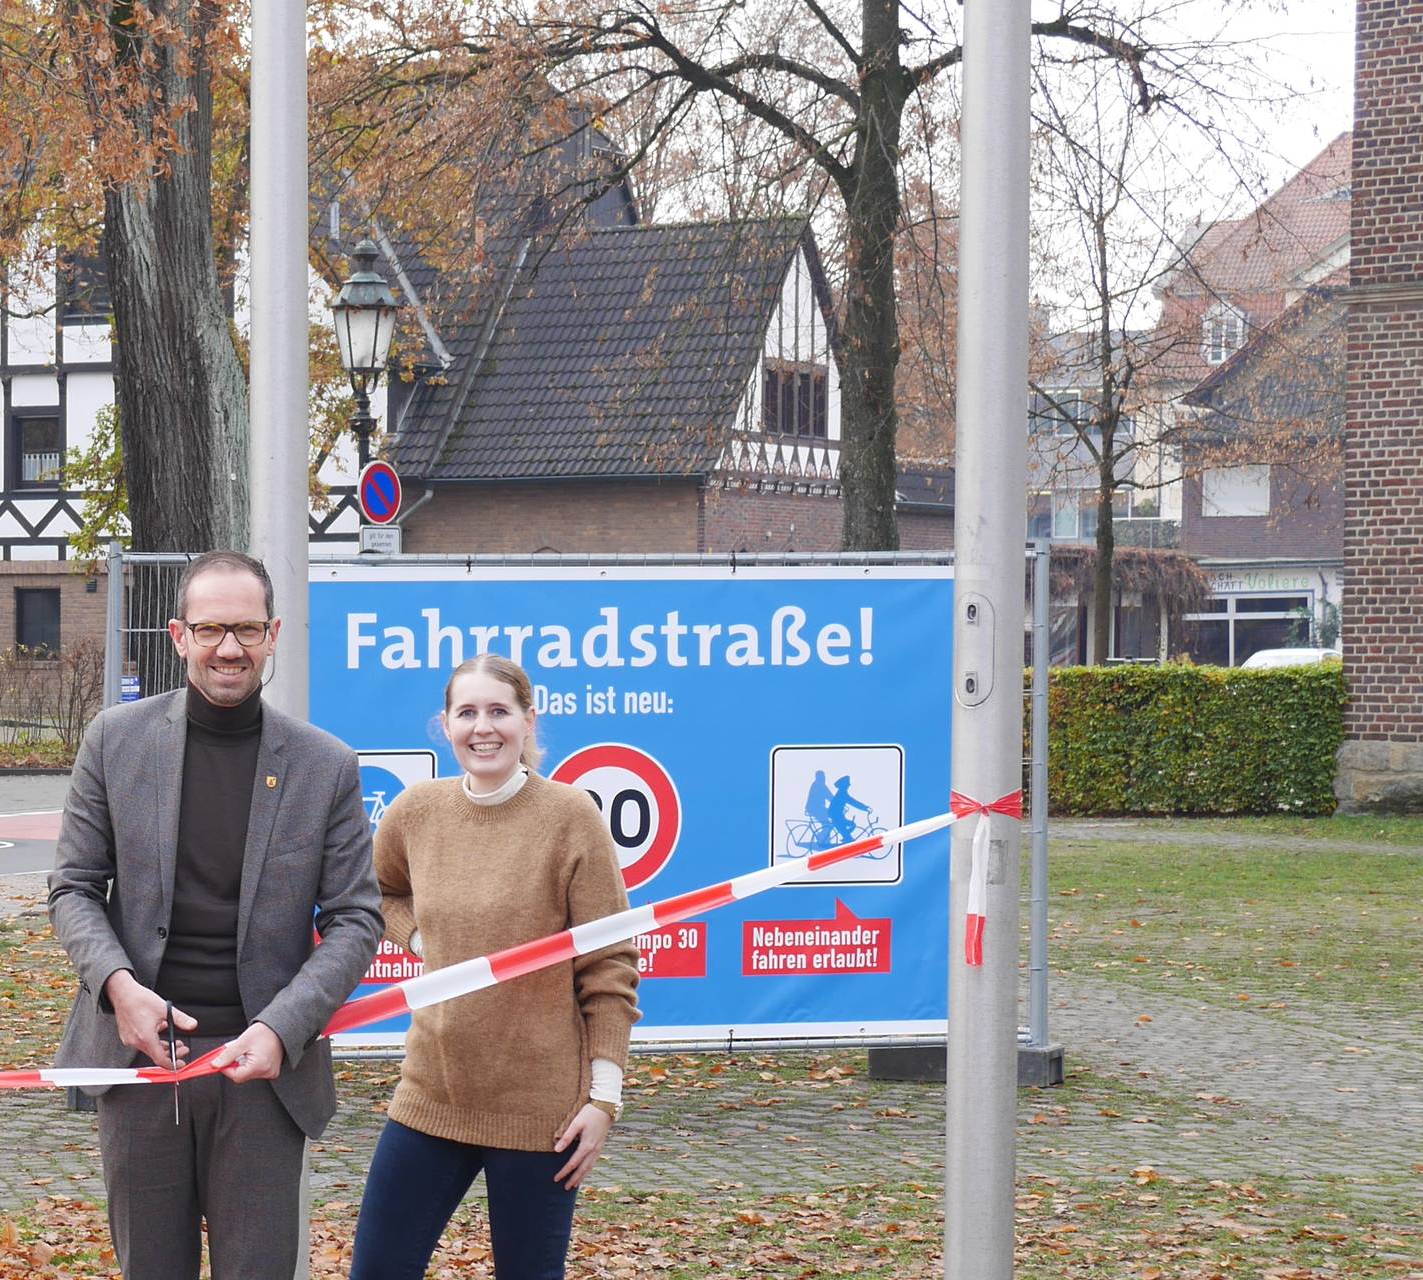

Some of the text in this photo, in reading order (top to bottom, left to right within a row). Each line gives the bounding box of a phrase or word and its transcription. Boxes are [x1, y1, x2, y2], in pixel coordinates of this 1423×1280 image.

[346, 605, 874, 670] Fahrradstraße!
[533, 684, 674, 715] Das ist neu:
[678, 928, 698, 949] 30
[752, 925, 880, 948] Nebeneinander
[637, 952, 654, 973] e!
[751, 947, 878, 970] fahren erlaubt!
